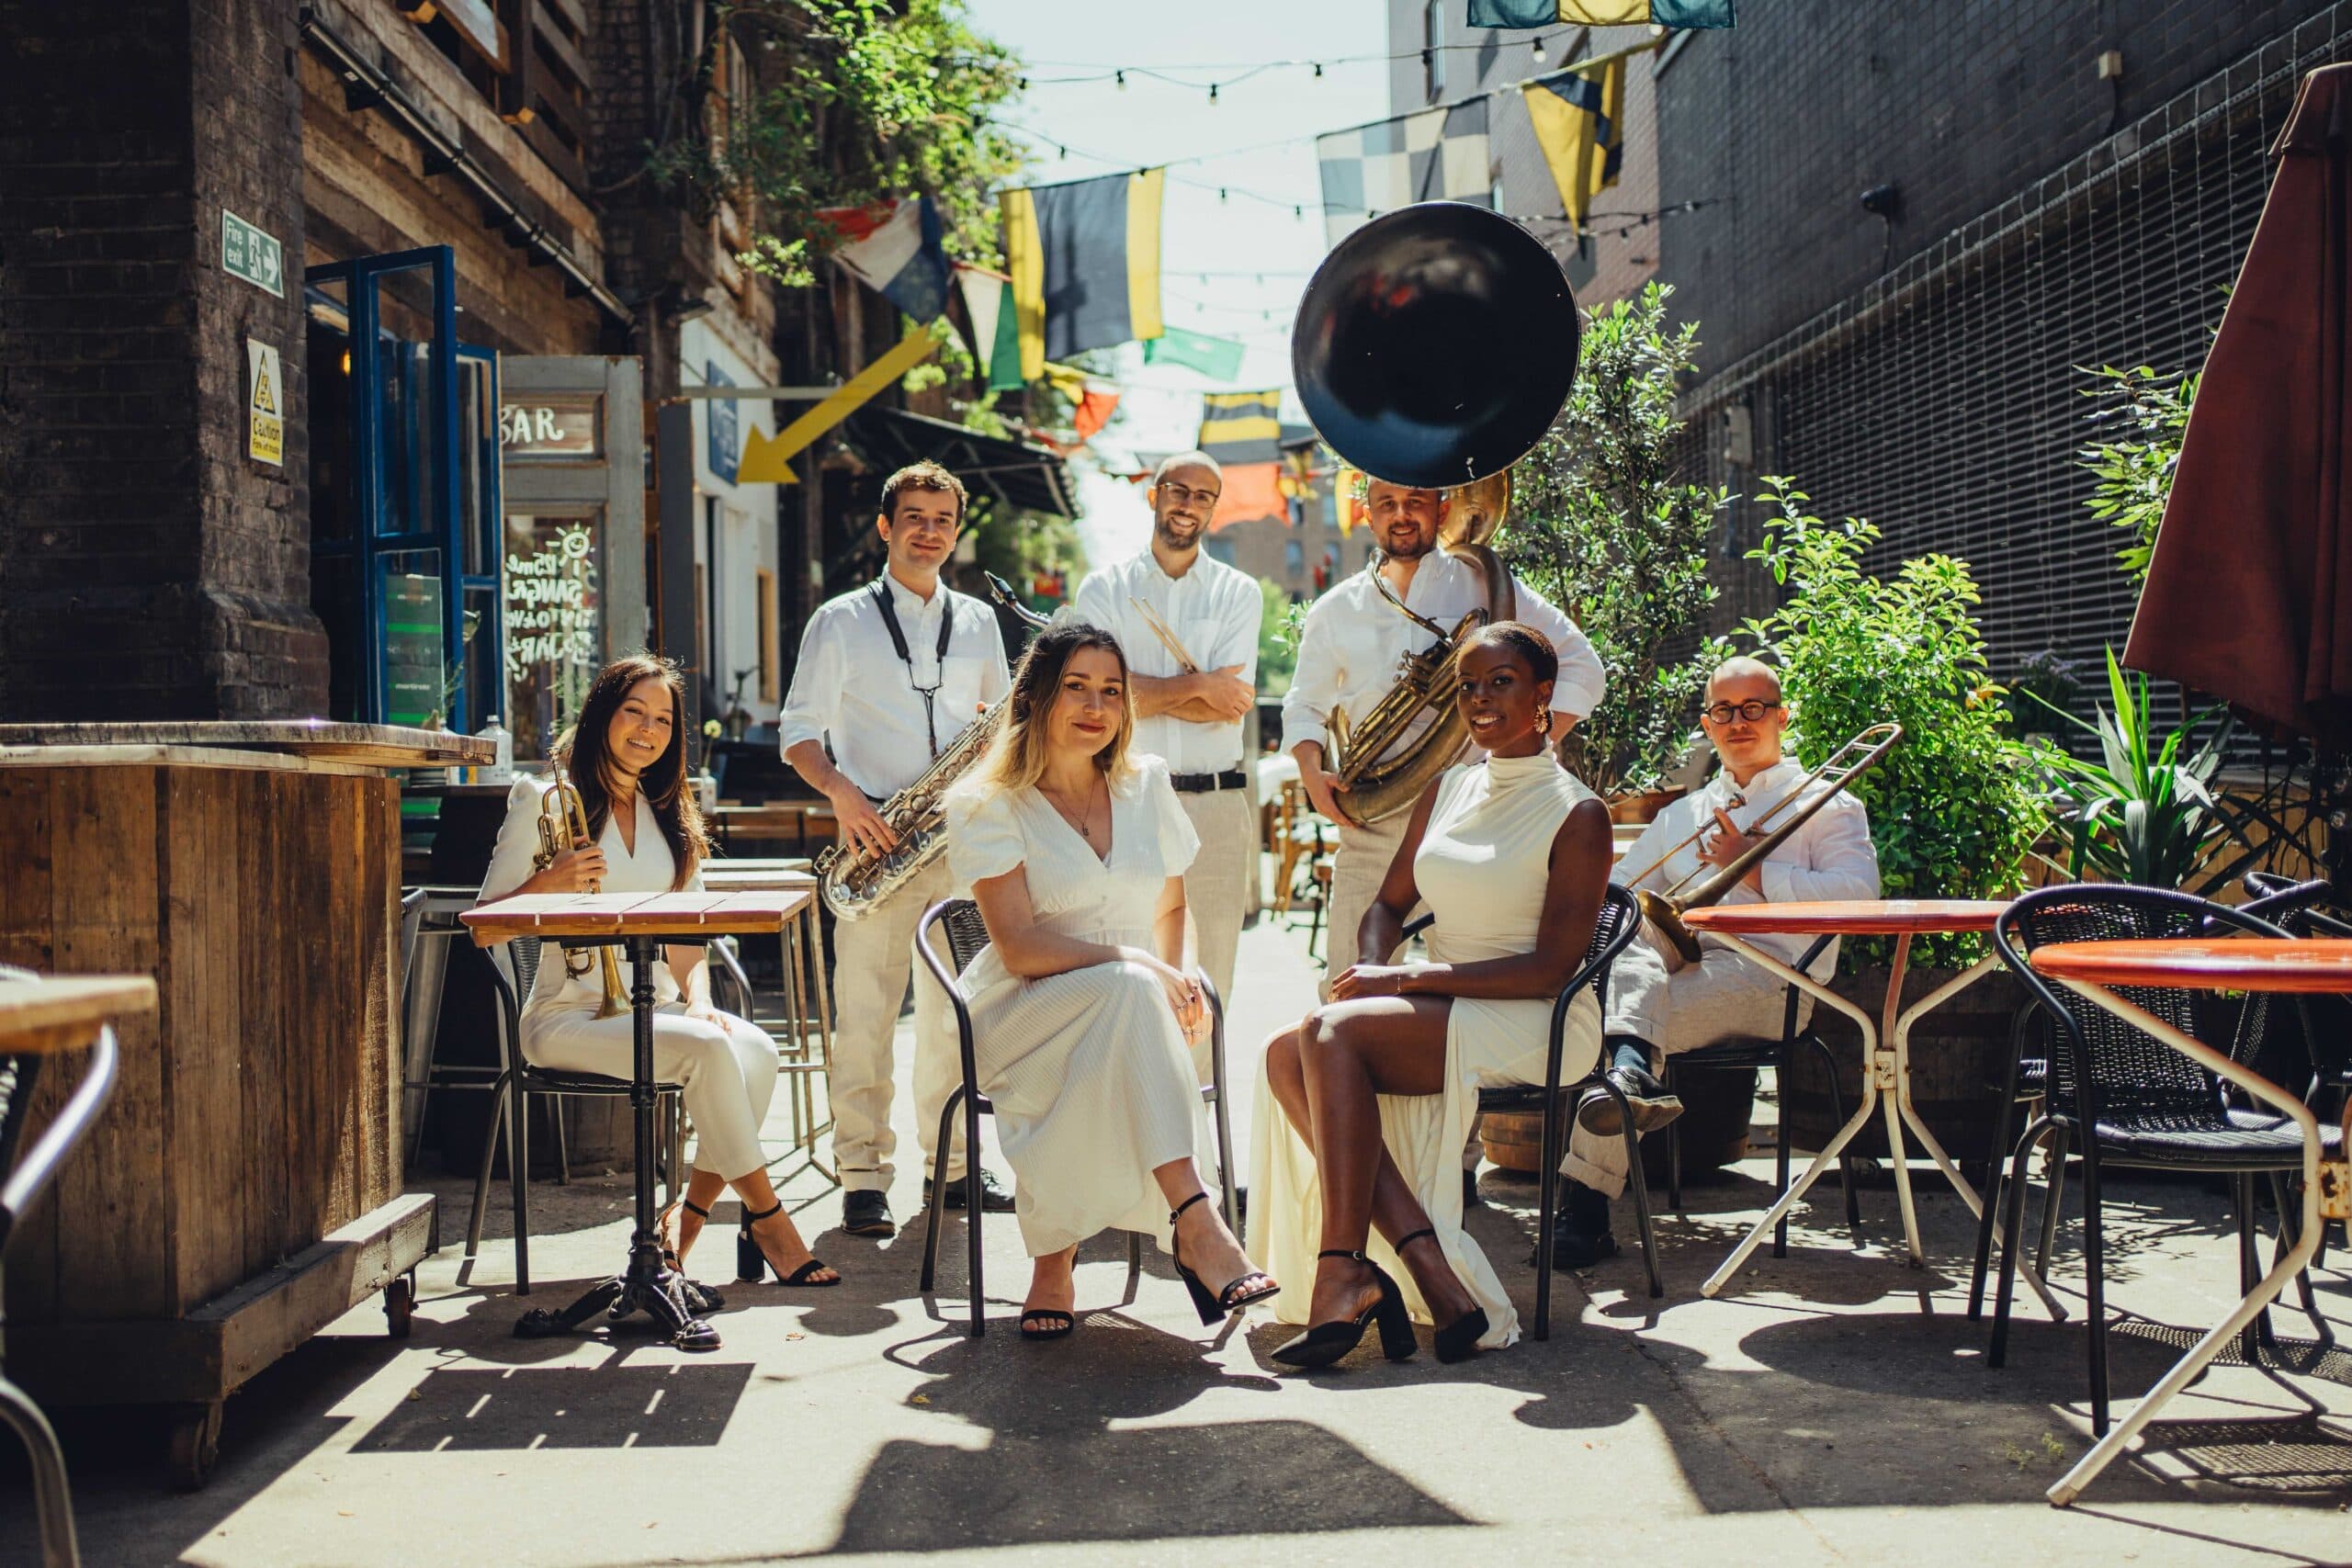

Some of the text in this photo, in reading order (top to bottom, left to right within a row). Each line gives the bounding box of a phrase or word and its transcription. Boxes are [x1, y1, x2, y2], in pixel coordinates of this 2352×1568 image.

[226, 220, 243, 245] Fire
[227, 247, 243, 269] exit
[253, 417, 280, 442] Caution
